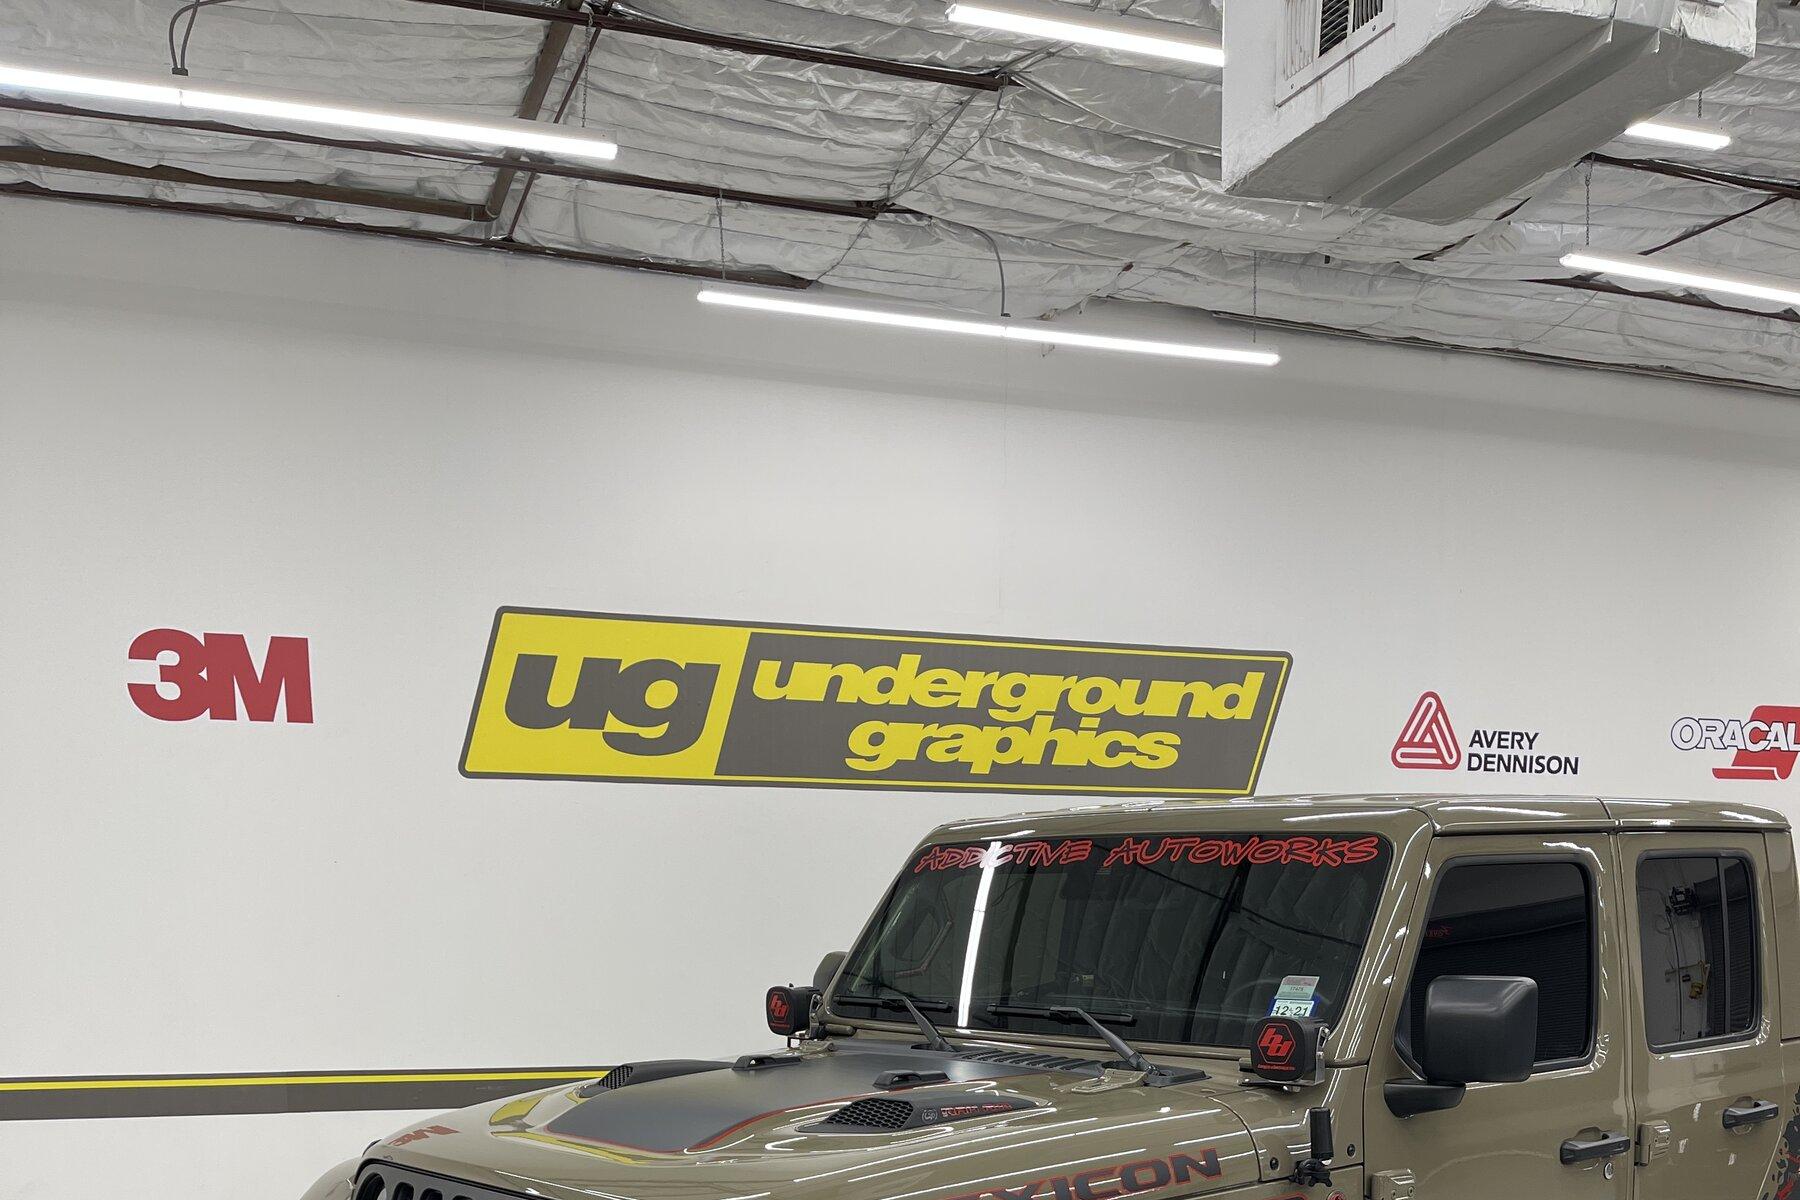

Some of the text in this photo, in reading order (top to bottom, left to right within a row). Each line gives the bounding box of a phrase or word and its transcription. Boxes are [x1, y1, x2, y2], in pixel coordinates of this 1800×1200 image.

[127, 628, 313, 723] 3M
[753, 654, 1265, 722] underground
[505, 653, 721, 756] ug
[845, 715, 1182, 775] graphics
[1469, 730, 1539, 750] AVERY
[1671, 717, 1800, 752] ORACAL
[1467, 754, 1579, 775] DENNISON
[914, 836, 1381, 873] ADDICTIVE AUTOWORKS
